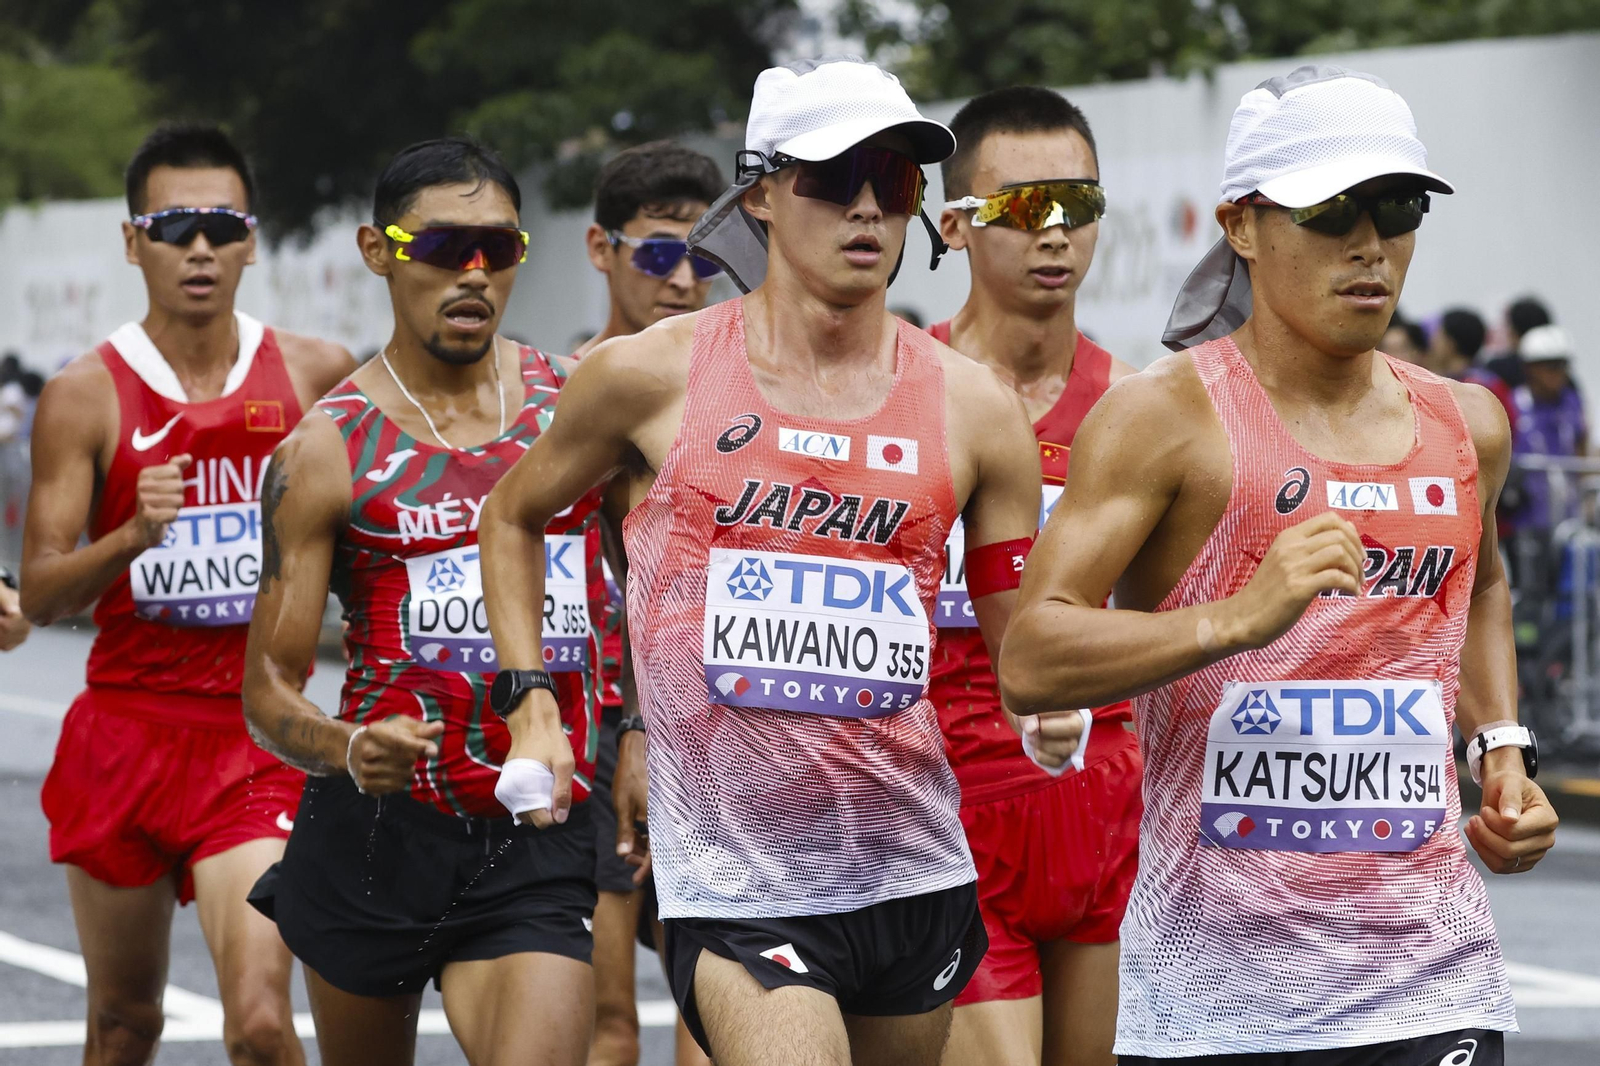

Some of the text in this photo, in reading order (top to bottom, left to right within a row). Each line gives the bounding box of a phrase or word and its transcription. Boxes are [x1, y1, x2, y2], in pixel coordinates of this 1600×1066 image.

[783, 432, 847, 458] ACN
[182, 455, 272, 505] HIN
[1331, 484, 1392, 509] ACN
[714, 480, 911, 546] JAPAN
[140, 553, 260, 596] WANG
[774, 559, 917, 618] TDK
[1318, 546, 1455, 600] PAN
[177, 598, 255, 620] TOKY
[562, 603, 586, 635] 365
[712, 614, 925, 681] KAWANO 355
[1280, 688, 1432, 736] TDK
[1213, 751, 1440, 803] KATSUKI 354
